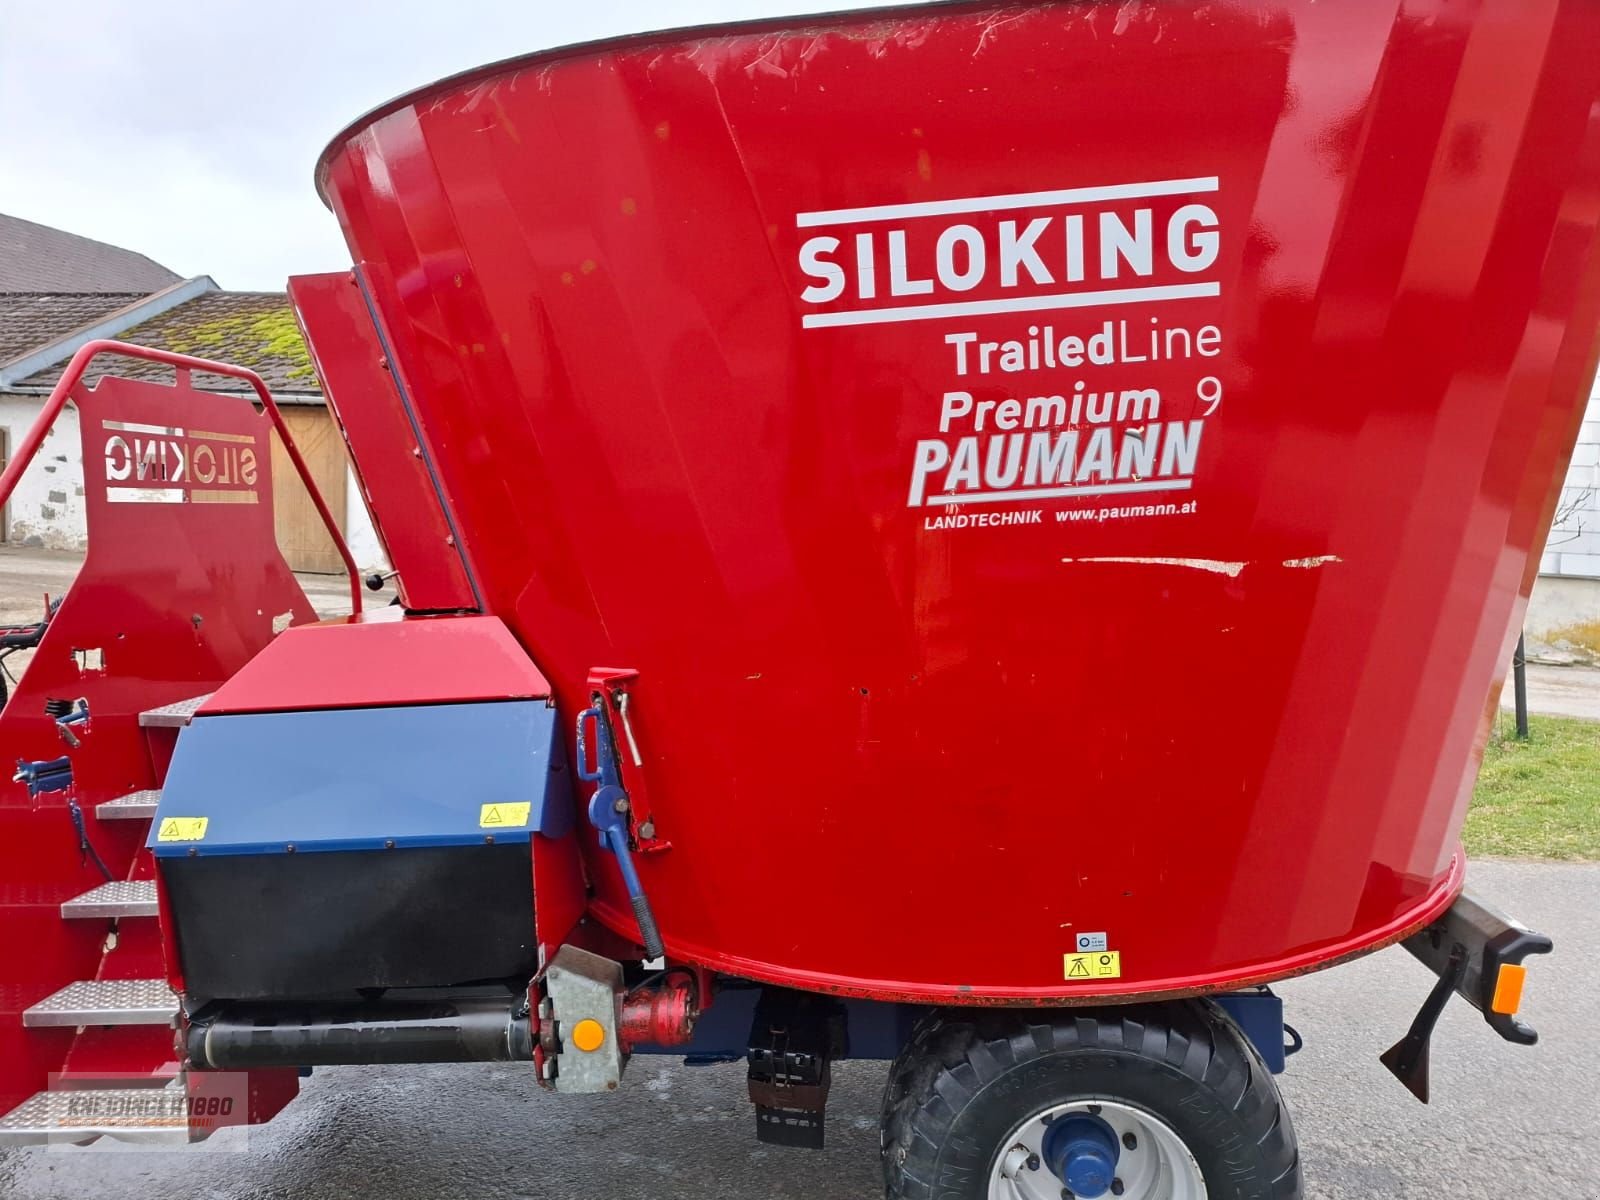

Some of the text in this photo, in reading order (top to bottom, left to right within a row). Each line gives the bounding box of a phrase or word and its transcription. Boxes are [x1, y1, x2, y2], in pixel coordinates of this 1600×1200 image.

[799, 204, 1220, 304] SILOKING
[945, 317, 1221, 375] TrailedLine
[939, 376, 1222, 432] Premium 9
[907, 419, 1205, 506] PAUMANN
[924, 500, 1198, 530] LANDTECHNIK www.paumann.at
